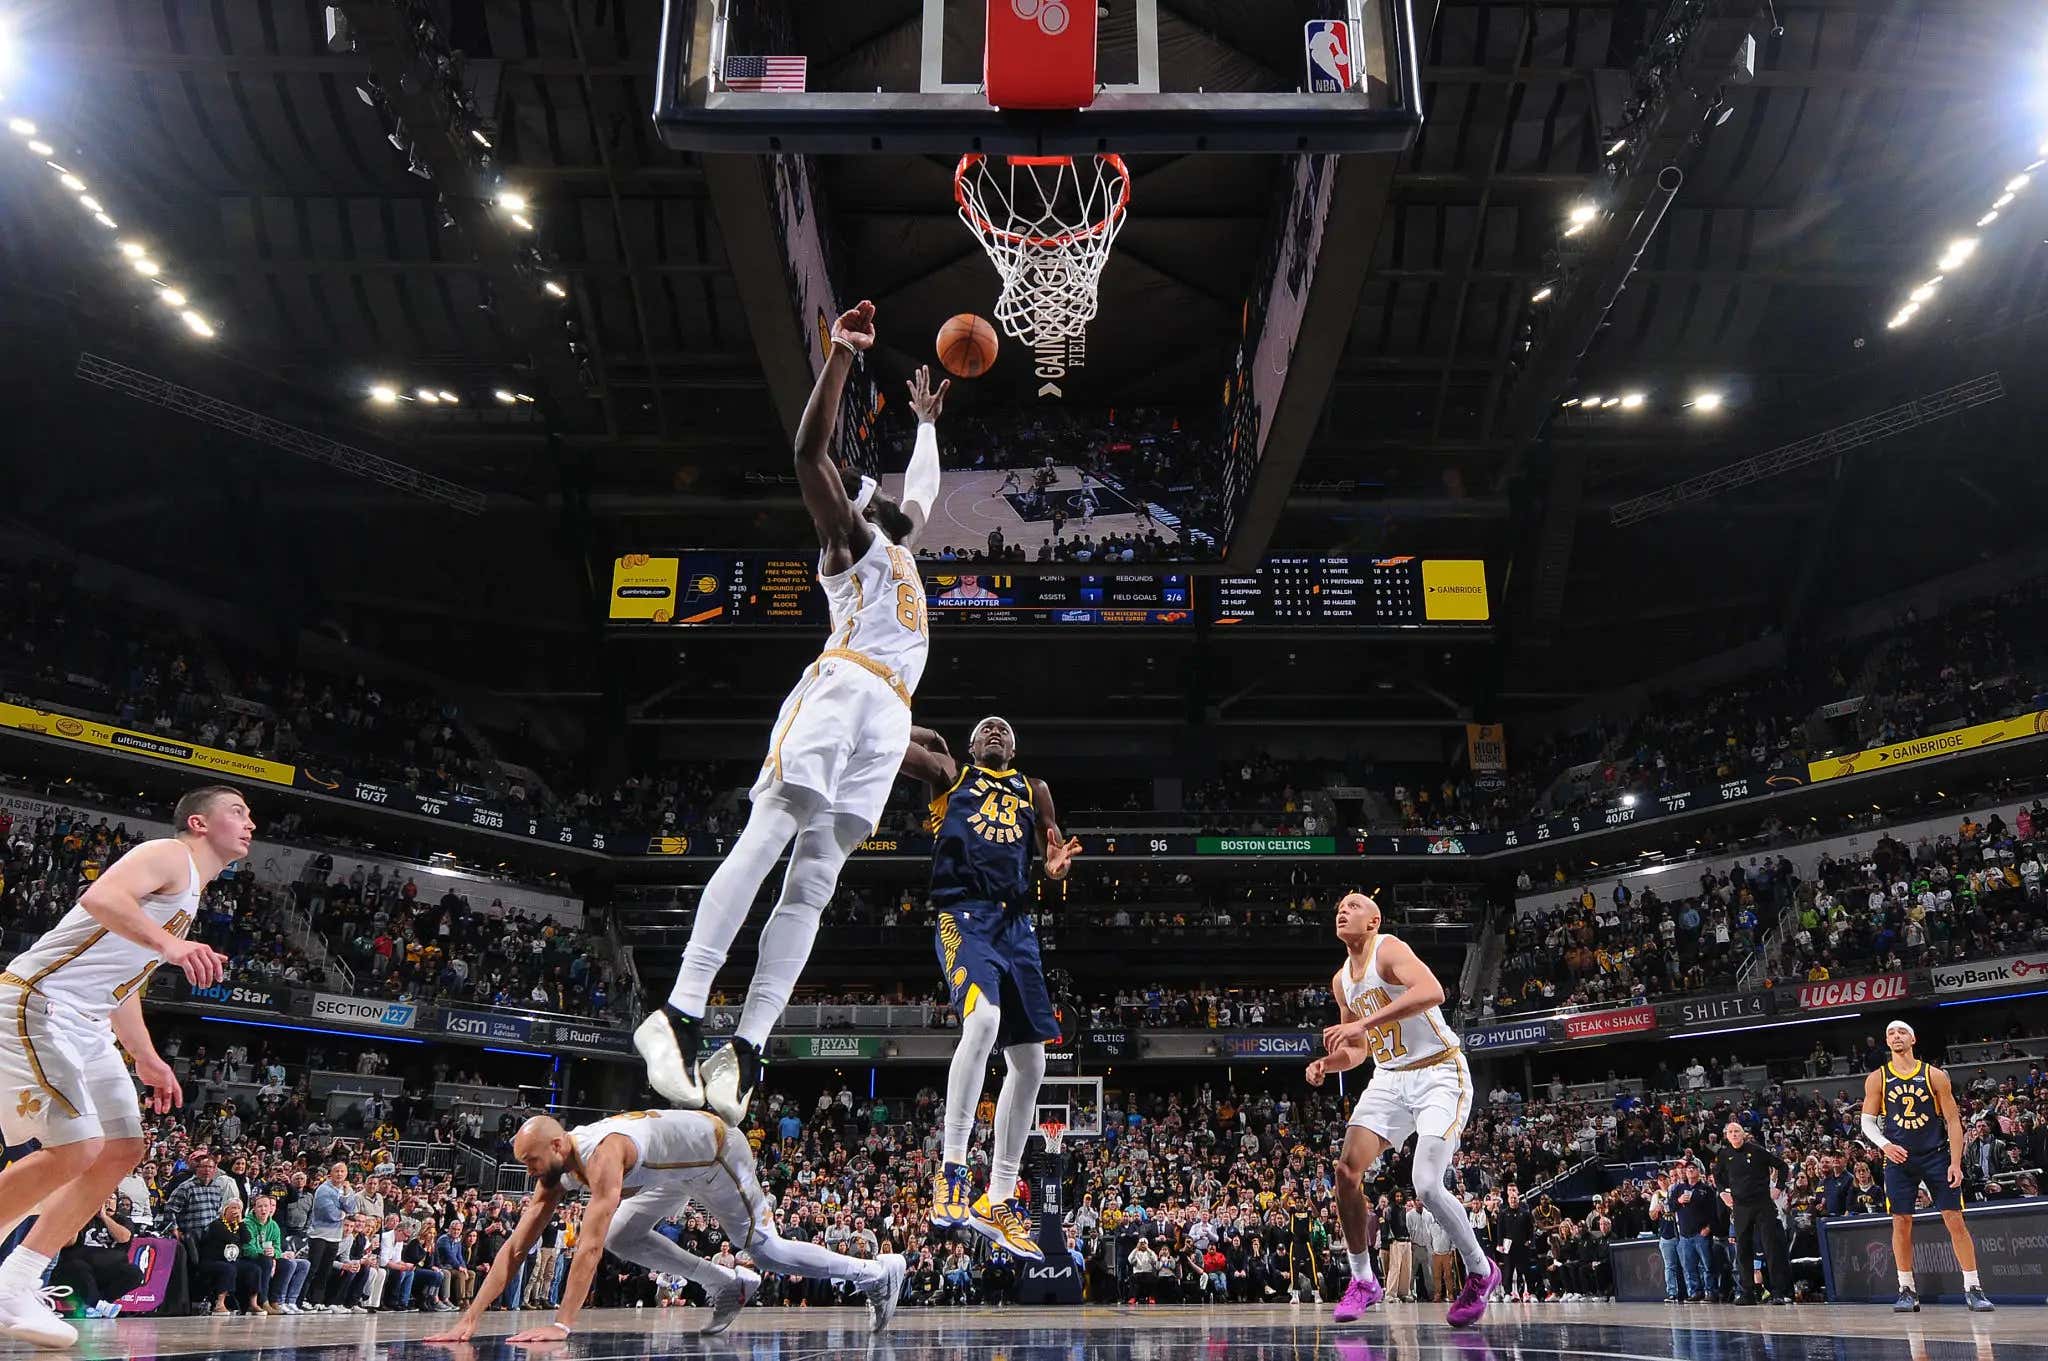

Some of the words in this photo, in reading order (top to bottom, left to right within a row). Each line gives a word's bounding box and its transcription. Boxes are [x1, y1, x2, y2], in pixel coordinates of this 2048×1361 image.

[1316, 79, 1336, 92] NBA
[1437, 586, 1482, 594] GAINBRIDGE
[90, 729, 109, 740] The
[118, 736, 156, 750] ultimate
[158, 745, 187, 757] assist
[194, 752, 208, 761] for
[210, 757, 230, 767] your
[1892, 734, 1963, 760] GAINBRIDGE
[355, 788, 387, 803] 16/37
[1722, 786, 1748, 799] 9/34
[421, 803, 440, 814] 4/6
[980, 791, 1018, 826] 43
[1667, 799, 1685, 811] 7/9
[473, 814, 503, 828] 38/83
[1605, 810, 1635, 824] 40/87
[529, 826, 536, 835] 8
[967, 812, 1023, 843] PACERS
[1538, 829, 1550, 839] 22
[1573, 823, 1580, 831] 9
[560, 832, 572, 842] 29
[593, 839, 604, 849] 39
[1506, 836, 1517, 845] 46
[856, 840, 897, 850] PACERS
[1150, 840, 1168, 851] 96
[1221, 840, 1266, 850] BOSTON
[1269, 840, 1310, 850] CELTICS
[1934, 967, 2010, 987] KeyBank
[1800, 983, 1869, 1007] LUCAS
[1872, 976, 1906, 999] OIL
[316, 1000, 382, 1019] SECTION
[385, 1009, 407, 1023] 127
[1683, 1000, 1744, 1021] SHIFT
[1752, 998, 1760, 1010] 4
[446, 1012, 486, 1034] ksm
[1568, 1019, 1602, 1033] STEAK
[1612, 1014, 1650, 1027] SHAKE
[570, 1032, 600, 1043] Ruoff
[1366, 1020, 1408, 1063] 27
[1488, 1026, 1546, 1043] HYUNDAI
[821, 1038, 859, 1049] RYAN
[1107, 1046, 1118, 1055] 96
[1228, 1038, 1311, 1052] SHIPSIGMA
[1888, 1084, 1929, 1103] INDIANA
[1902, 1096, 1916, 1117] 2
[1893, 1113, 1929, 1129] PACERS
[1046, 1185, 1056, 1194] GET
[1046, 1194, 1056, 1203] THE
[1981, 1236, 2005, 1252] NBC
